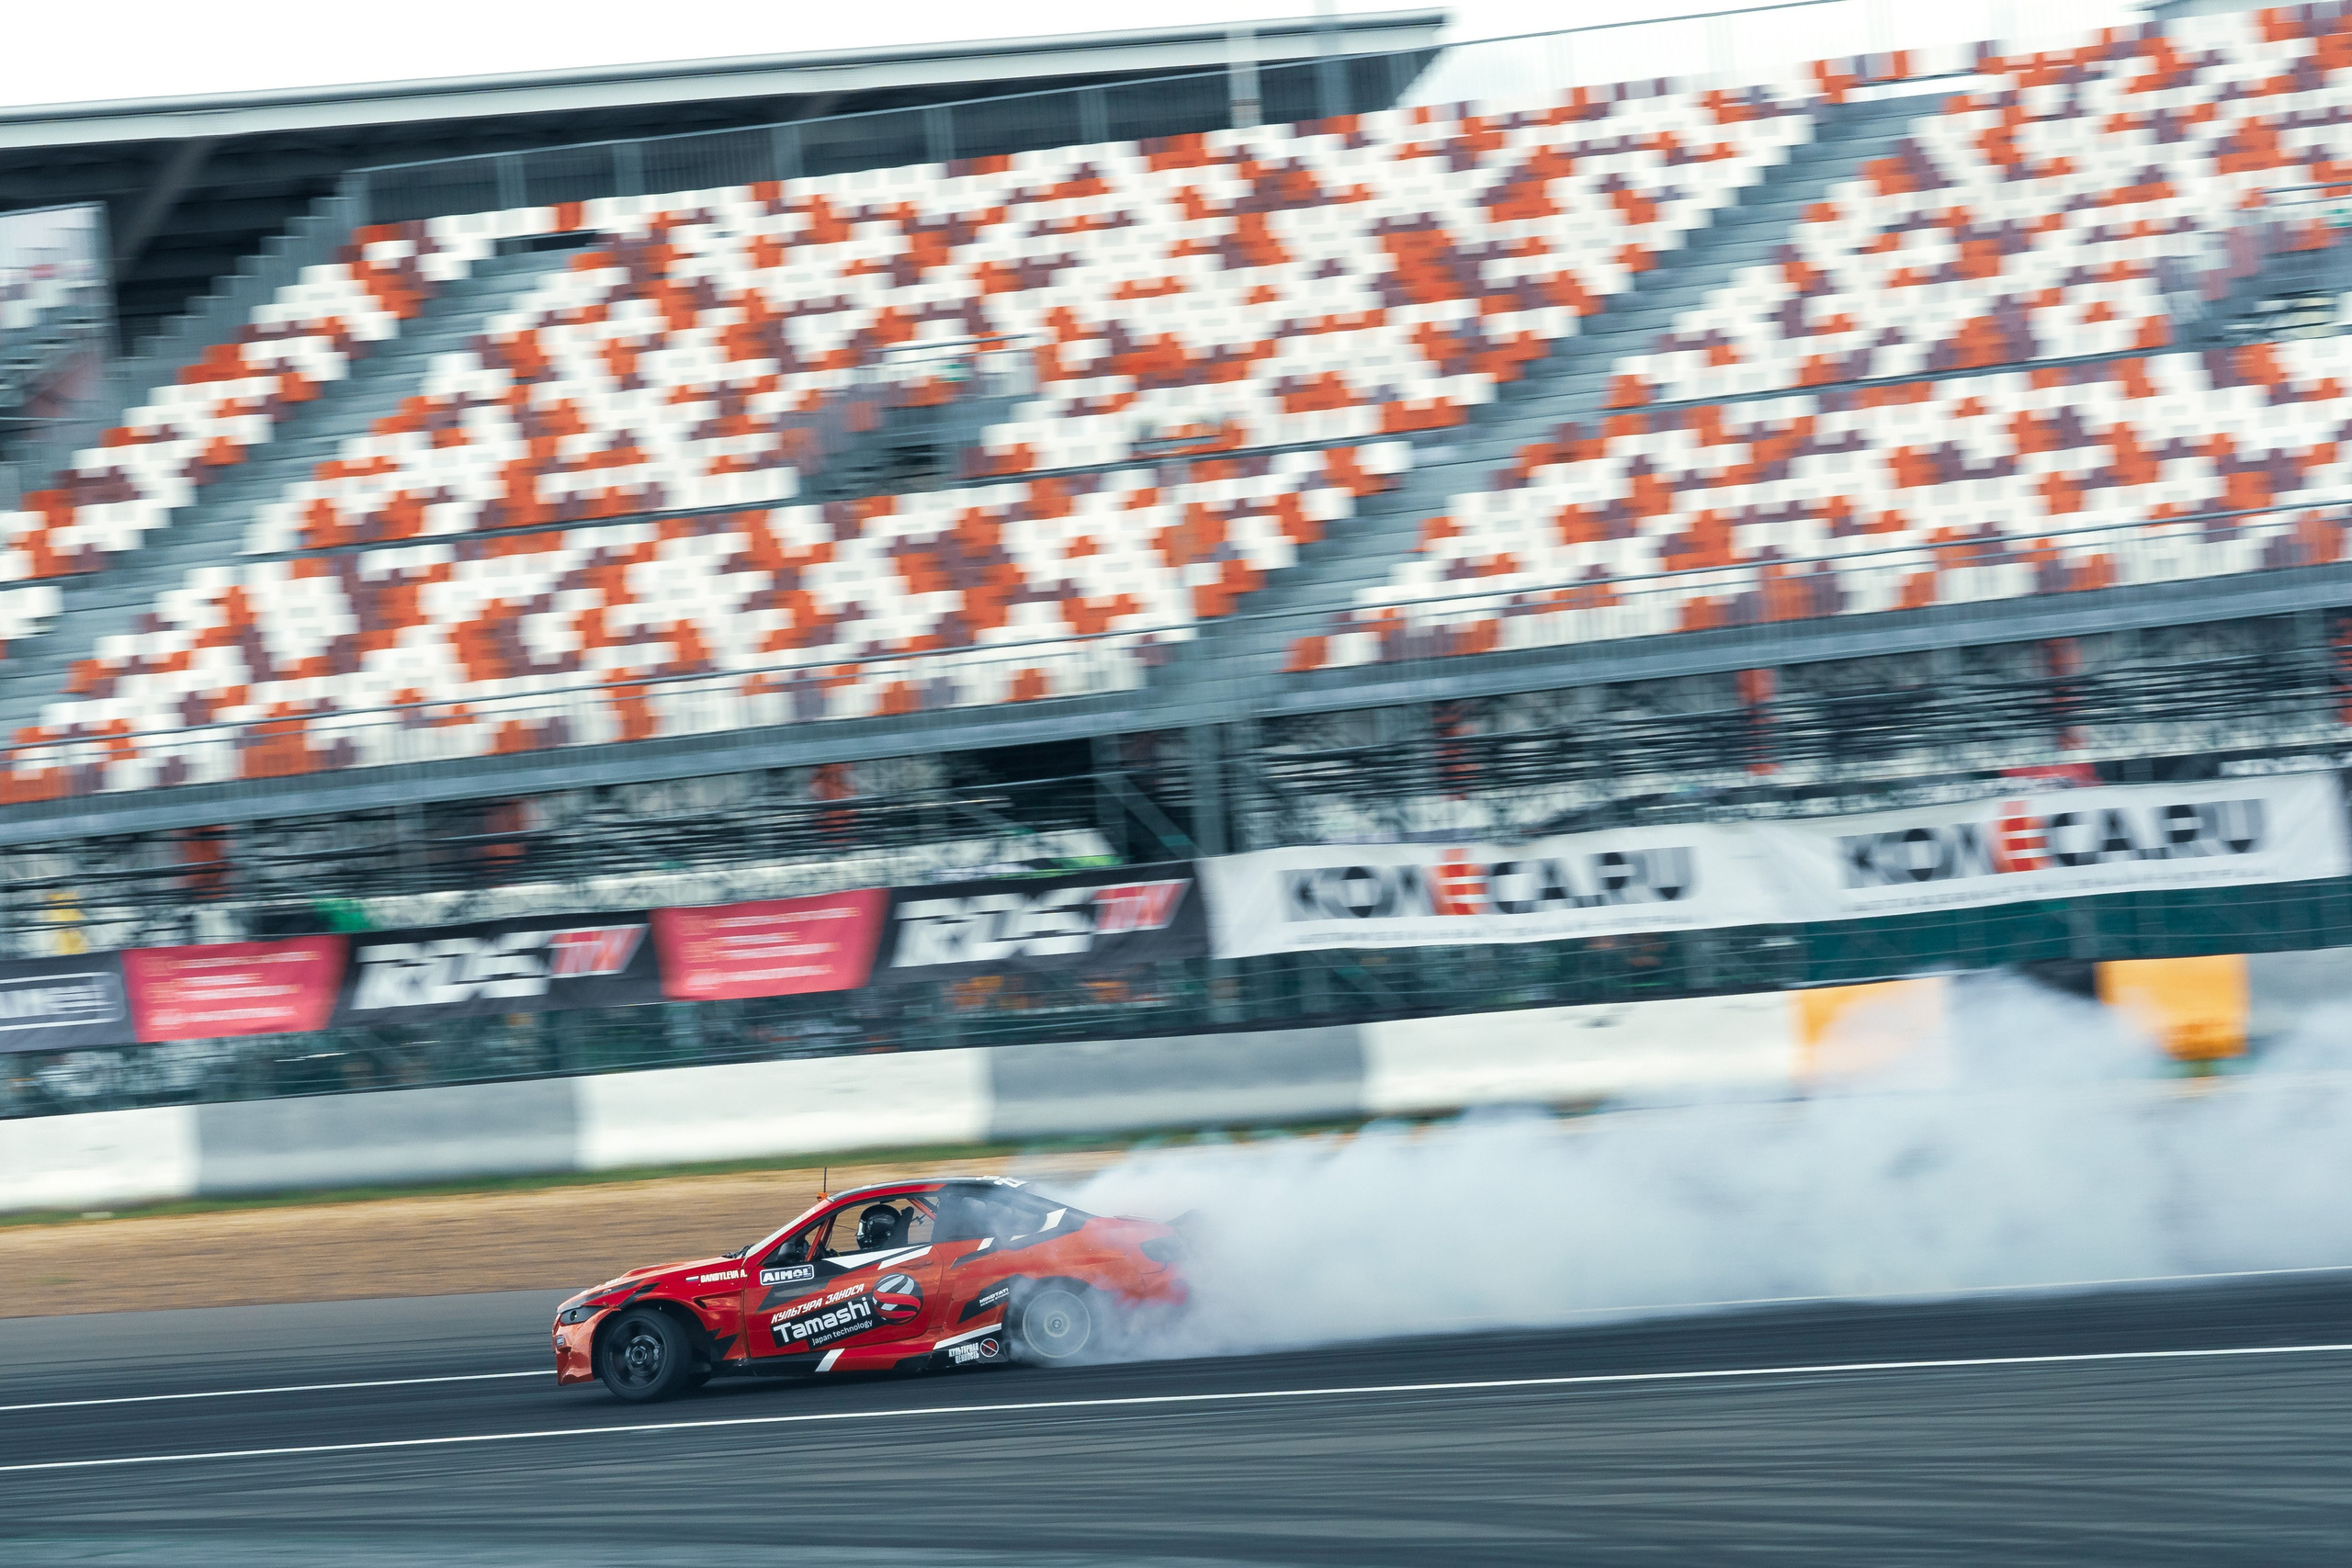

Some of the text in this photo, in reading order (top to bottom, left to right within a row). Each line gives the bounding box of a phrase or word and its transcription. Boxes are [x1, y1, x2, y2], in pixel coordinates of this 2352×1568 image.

[889, 886, 1095, 967] RDS
[351, 931, 553, 1010] RDS
[763, 1268, 812, 1283] AIMOL
[771, 1283, 865, 1324] КУЛЬТУРА ЗАНОСА
[773, 1296, 871, 1343] Tamashi
[812, 1319, 873, 1346] Japan technology
